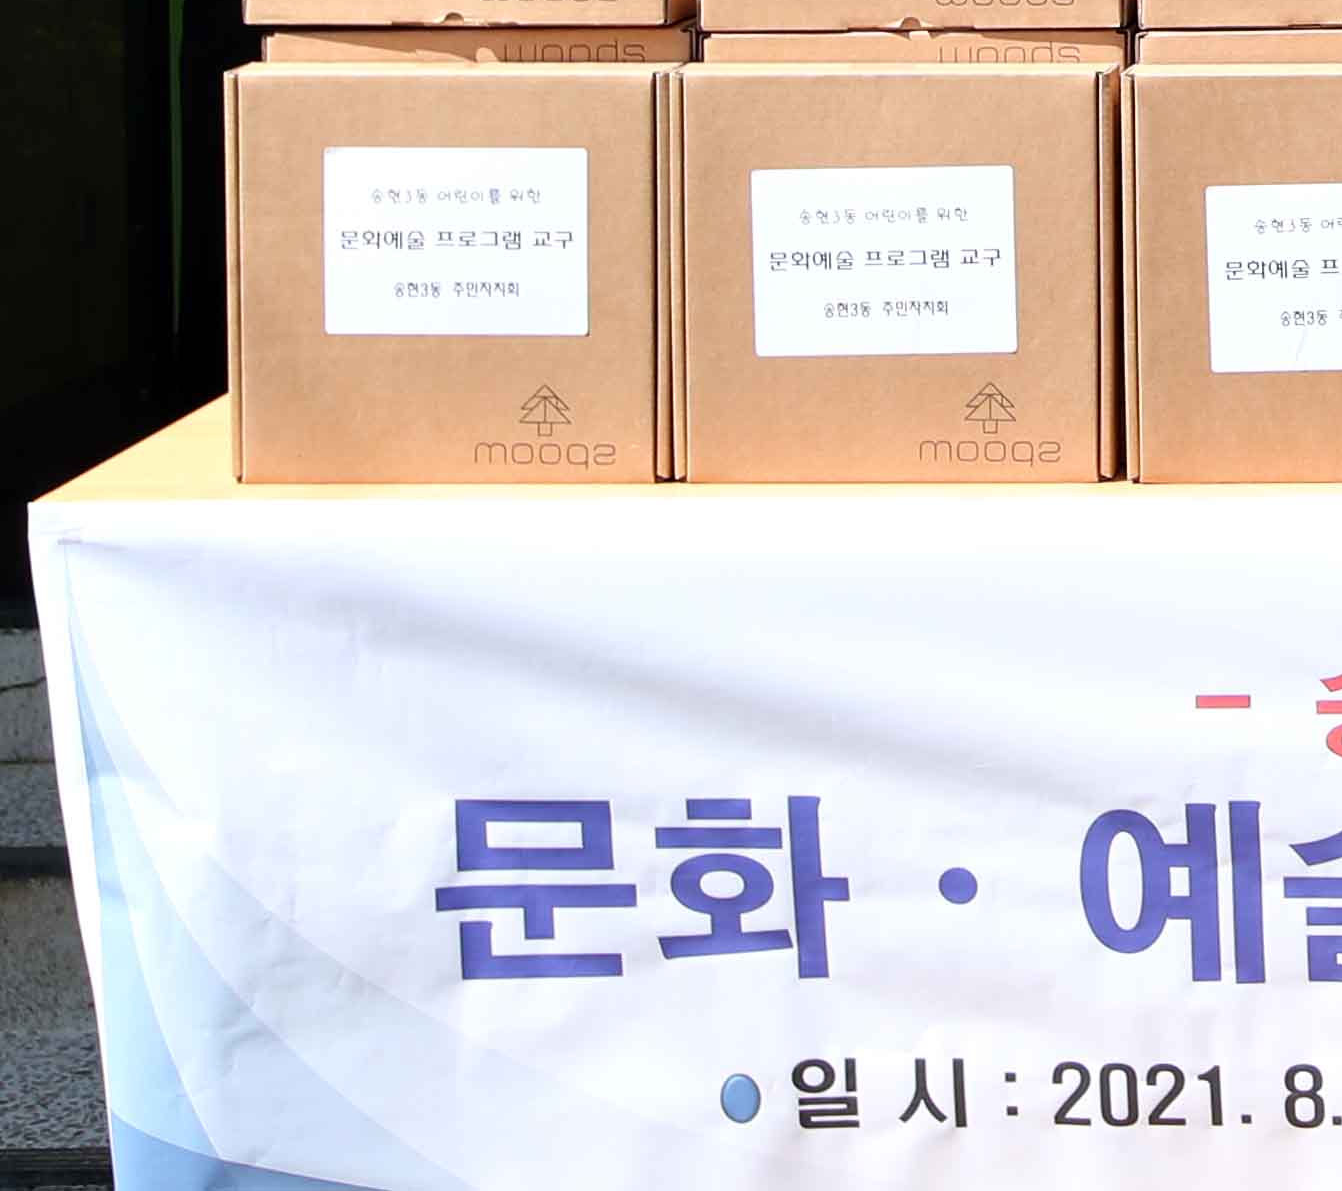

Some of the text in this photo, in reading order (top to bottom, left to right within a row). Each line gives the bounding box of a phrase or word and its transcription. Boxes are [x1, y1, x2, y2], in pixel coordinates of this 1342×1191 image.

[505, 40, 646, 63] woods
[372, 187, 541, 206] 송현3동 어린이를 위한
[799, 206, 968, 225] 송현3동 어린이를 위한
[1254, 217, 1313, 235] 송현3동
[341, 230, 573, 250] 문화예술 프로그램 교구
[770, 248, 1001, 272] 문화예술 프로그램 교구
[1226, 259, 1309, 281] 문화예술
[395, 281, 520, 298] 송현3동 주민자치회
[823, 300, 949, 319] 송현3동 주민자치회
[1281, 309, 1328, 327] 송현3동
[434, 795, 850, 981] 문화
[790, 1058, 861, 1130] 일
[900, 1058, 968, 1129] 시
[1051, 1061, 1253, 1128] 2021.
[1283, 1064, 1342, 1130] 8.
